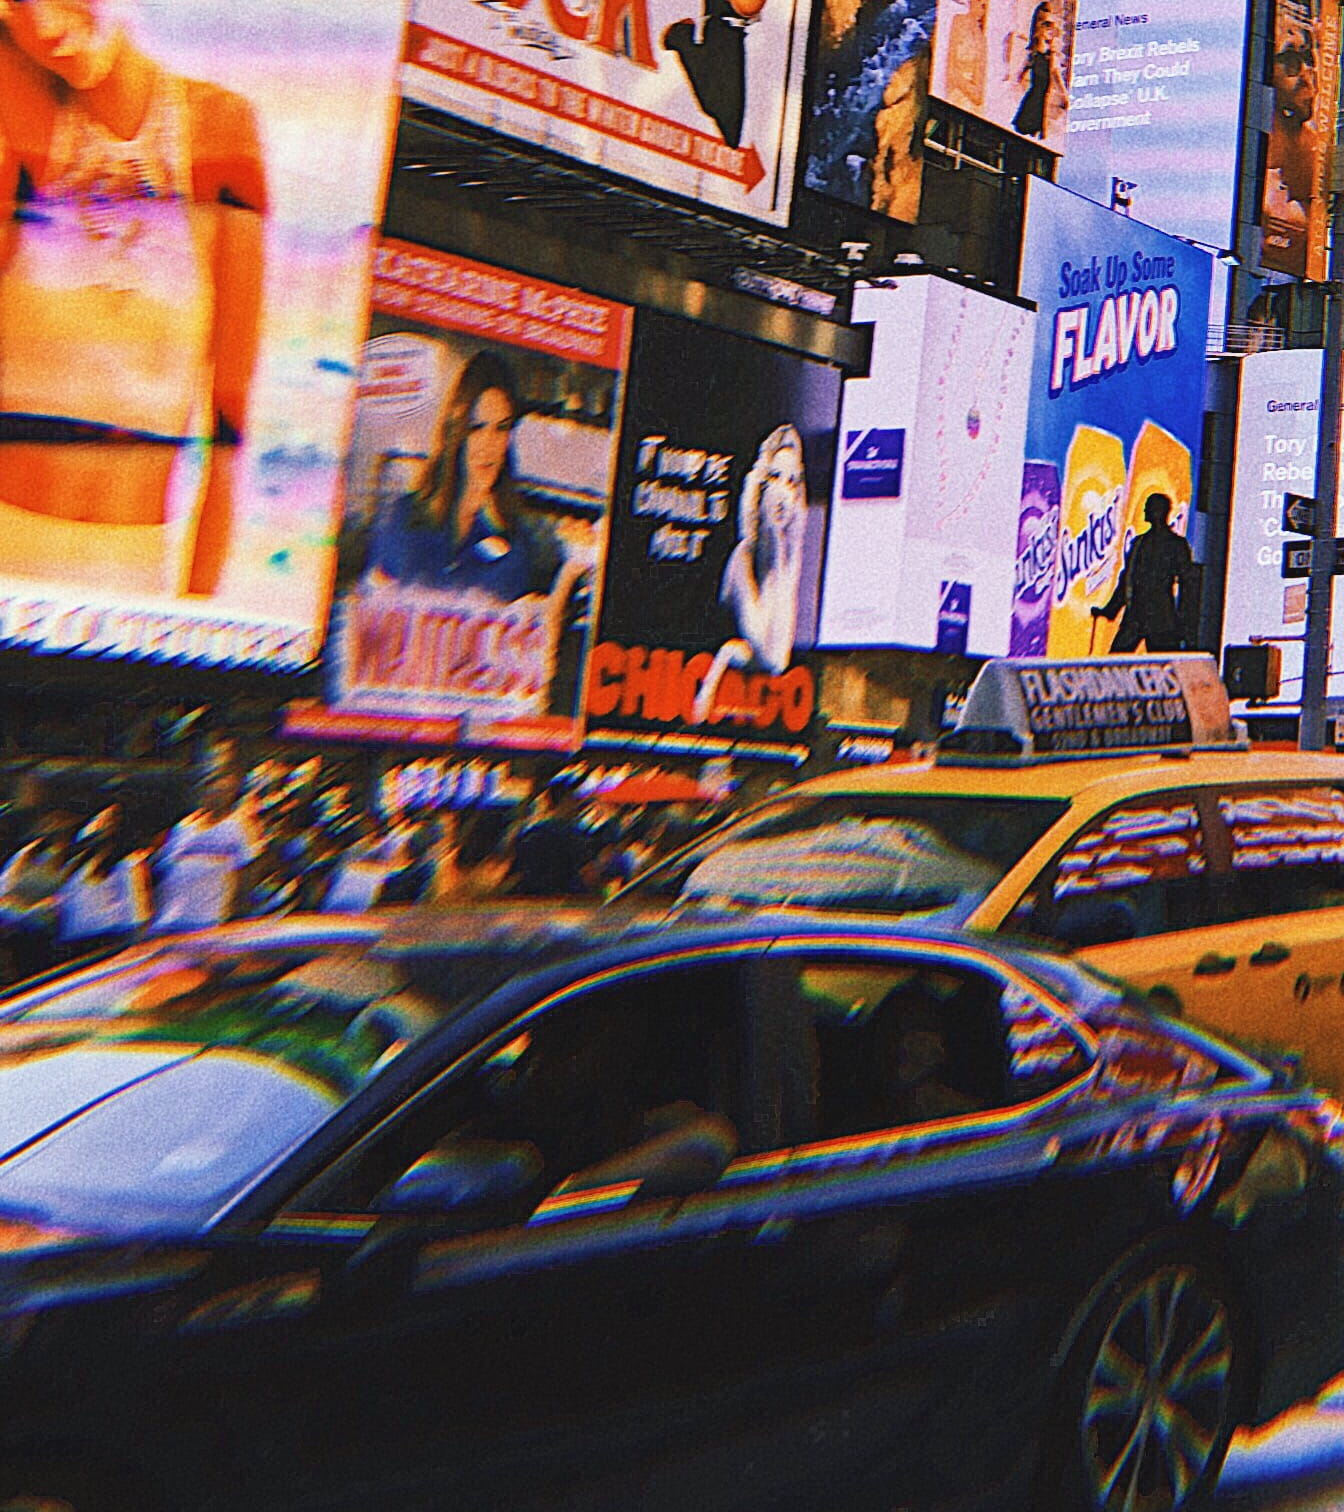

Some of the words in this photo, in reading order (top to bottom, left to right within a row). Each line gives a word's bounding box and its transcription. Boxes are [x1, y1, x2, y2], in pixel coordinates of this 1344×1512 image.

[1075, 15, 1112, 31] eneral
[1114, 13, 1149, 27] News
[1072, 51, 1095, 67] ory
[1098, 44, 1144, 64] Brexit
[1147, 38, 1201, 58] Rebels
[1071, 73, 1099, 89] arn
[1103, 68, 1141, 87] They
[1144, 60, 1190, 80] Could
[1317, 12, 1340, 134] WELCOME
[1058, 255, 1102, 299] Soak
[1105, 254, 1128, 294] Up
[1132, 250, 1176, 283] Some
[1048, 286, 1180, 396] FLAVOR
[1266, 399, 1319, 412] General
[1263, 435, 1307, 456] Tory
[587, 640, 814, 733] CHICAGO
[1021, 662, 1183, 706] FLASHDANCERS
[1030, 702, 1144, 734] GENTLEMEN'S
[1146, 699, 1187, 725] CLUB
